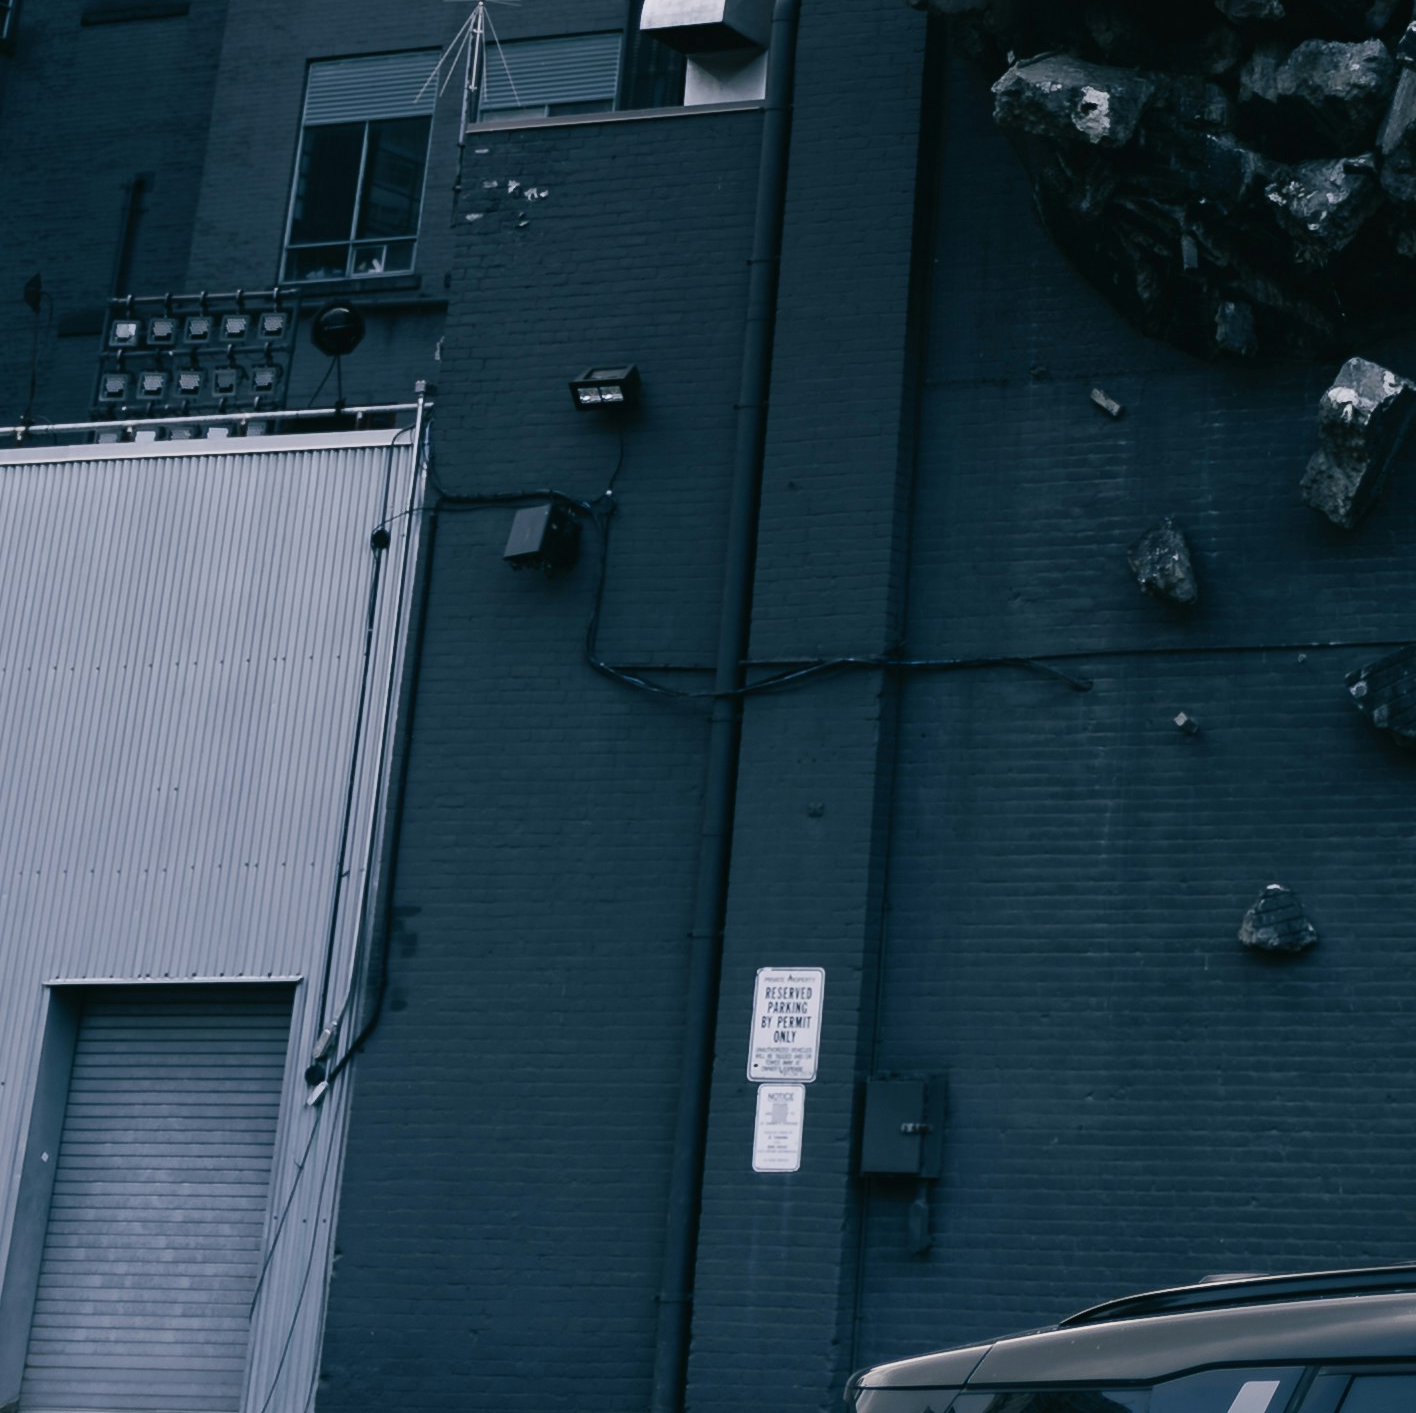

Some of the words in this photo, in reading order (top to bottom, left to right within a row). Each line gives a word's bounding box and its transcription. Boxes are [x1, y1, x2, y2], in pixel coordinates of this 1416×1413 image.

[765, 986, 813, 1001] RESERVED
[767, 1001, 808, 1014] PARKING
[761, 1015, 772, 1029] BY
[777, 1015, 812, 1029] PERMIT
[773, 1030, 797, 1043] ONLY
[767, 1092, 794, 1102] NOTICE
